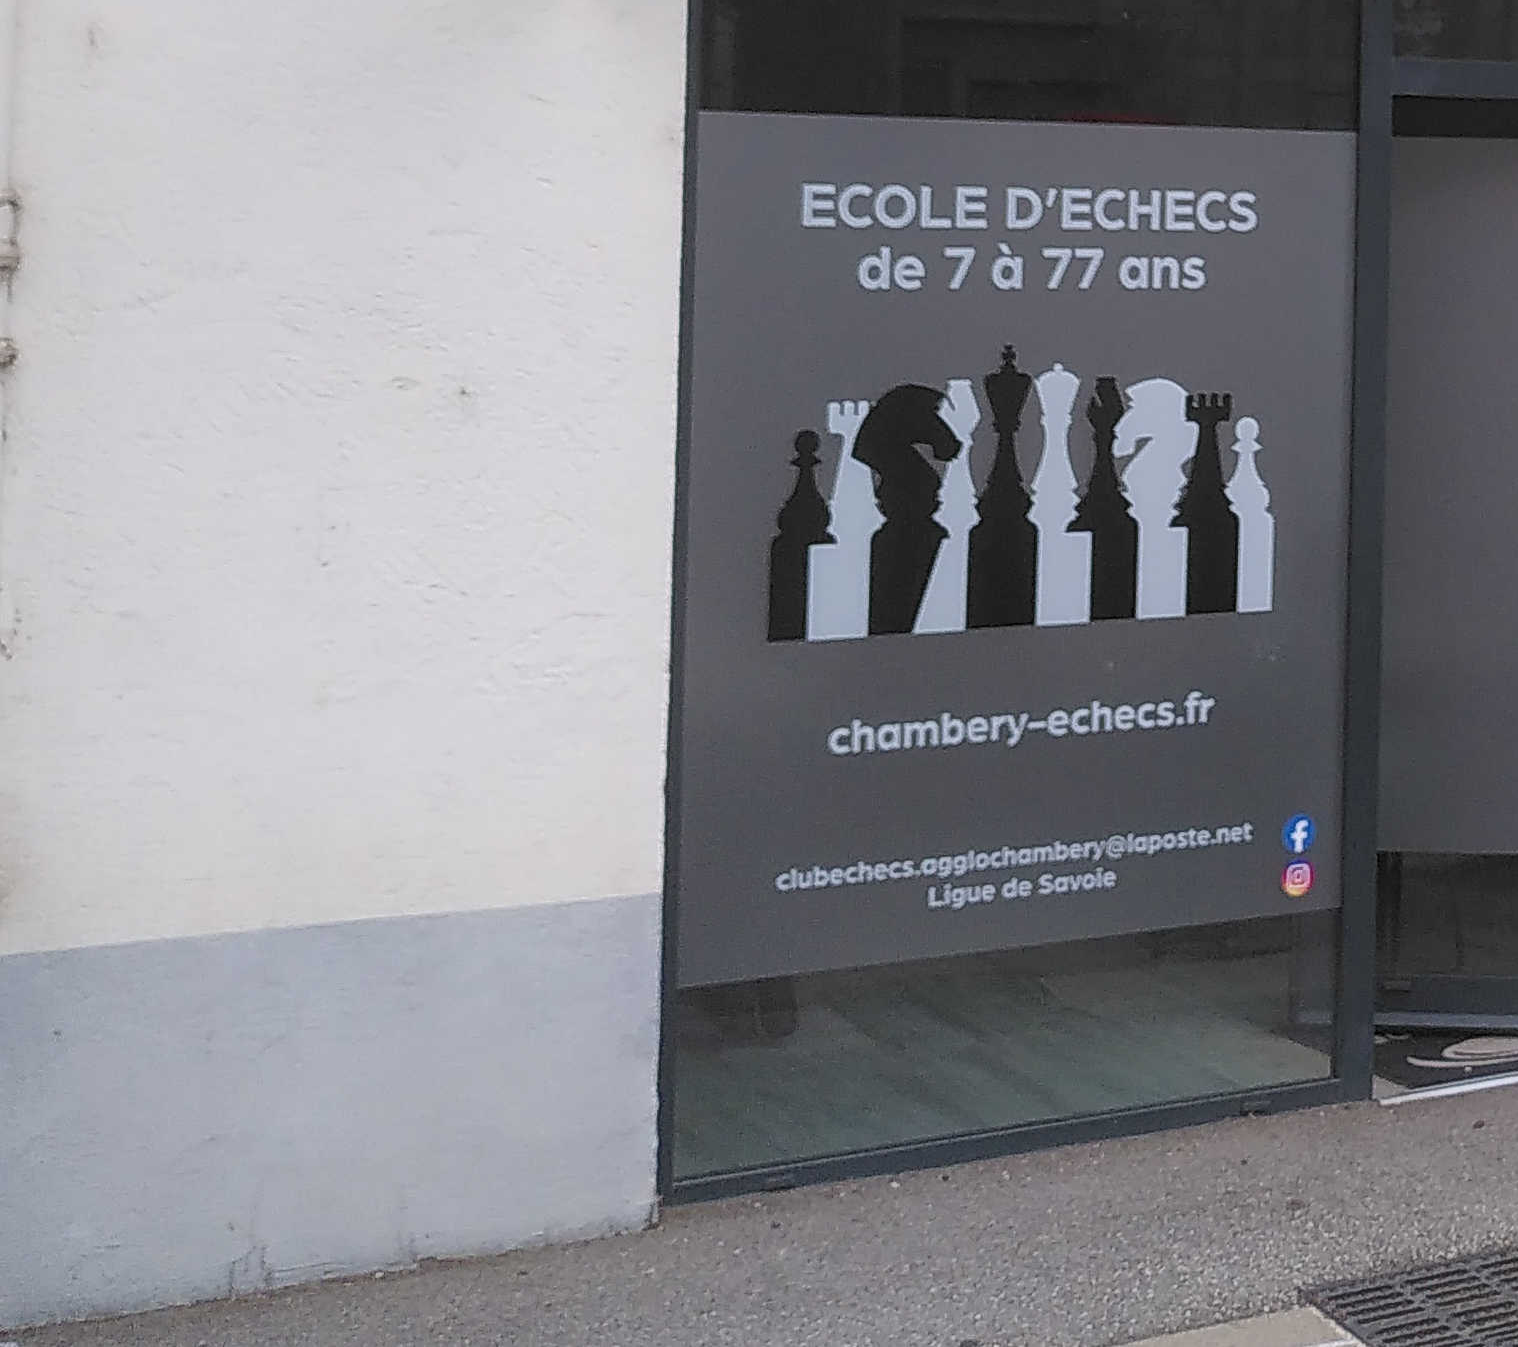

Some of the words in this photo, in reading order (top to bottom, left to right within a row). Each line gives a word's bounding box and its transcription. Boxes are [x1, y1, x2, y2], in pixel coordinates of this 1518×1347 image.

[801, 183, 989, 231] ECOLE
[1006, 187, 1259, 233] D'ECHECS
[857, 246, 926, 291] de
[944, 246, 977, 290] 7
[992, 243, 1024, 291] à
[1042, 248, 1105, 290] 77
[1118, 255, 1207, 291] ans
[827, 691, 1216, 755] chambery-echecs.fr
[774, 822, 1254, 892] clubechecs.agglochambery@laposte.net
[927, 883, 995, 910] Ligue
[1001, 877, 1034, 901] de
[1038, 867, 1118, 894] Savoie
